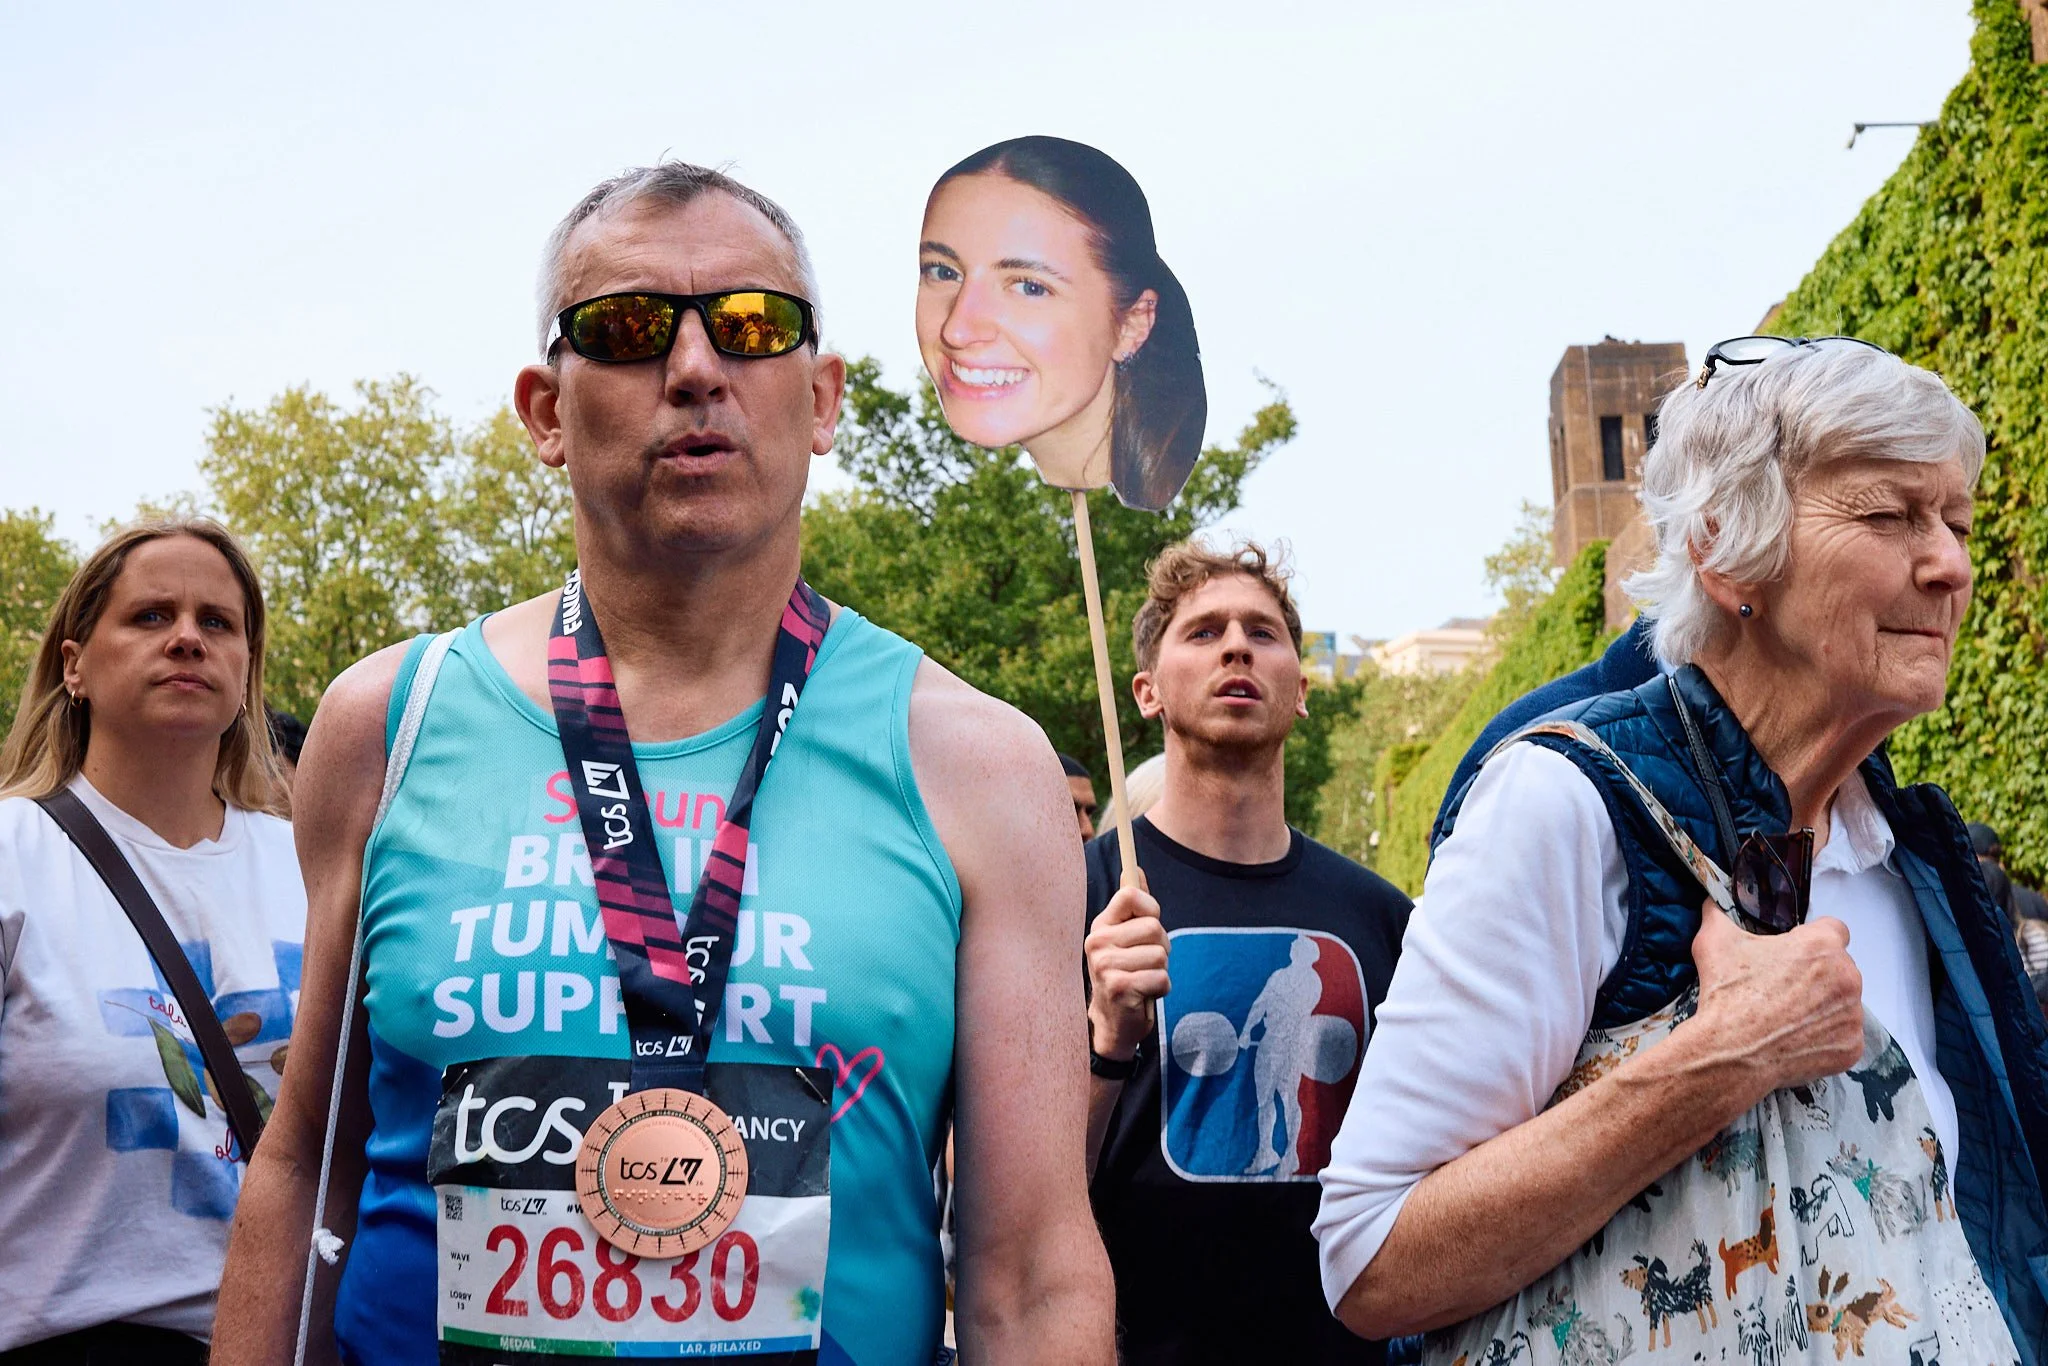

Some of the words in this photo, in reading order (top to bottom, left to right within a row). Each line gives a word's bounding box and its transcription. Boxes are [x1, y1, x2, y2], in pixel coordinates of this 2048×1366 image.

[543, 771, 726, 831] Sun
[600, 803, 634, 851] tcs
[504, 832, 759, 896] BRI
[450, 900, 813, 971] TUMUR
[432, 970, 828, 1047] SUPPRT
[636, 1040, 664, 1056] tcs
[455, 1083, 586, 1165] tcs
[728, 1116, 806, 1143] ANCY
[620, 1157, 658, 1180] tcs
[501, 1196, 521, 1212] tcs
[450, 1251, 470, 1262] WAVE
[485, 1224, 760, 1324] 26830
[450, 1290, 472, 1301] LORRY
[500, 1335, 537, 1351] MEDAL
[679, 1343, 706, 1355] LAR,
[709, 1340, 762, 1354] RELAXED
